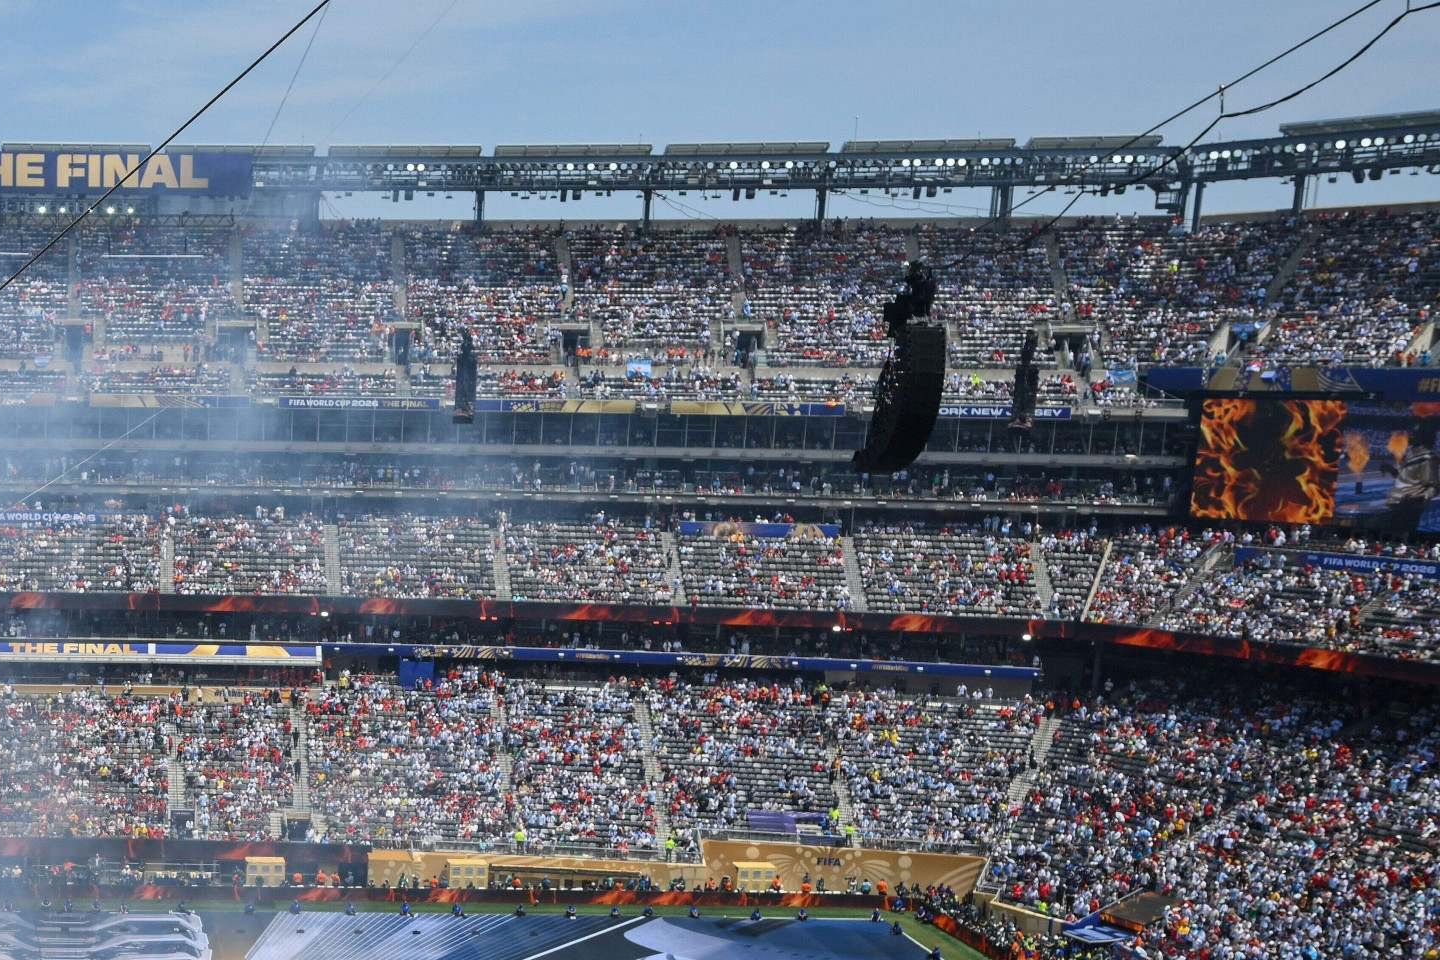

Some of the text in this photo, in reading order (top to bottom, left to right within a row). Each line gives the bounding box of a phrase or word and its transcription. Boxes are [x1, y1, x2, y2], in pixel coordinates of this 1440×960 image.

[56, 154, 209, 188] FINAL
[289, 399, 305, 407] FIFA
[305, 399, 334, 407] WORLD
[382, 400, 400, 408] THE
[401, 400, 429, 408] FINAL
[971, 408, 1003, 416] NEW
[6, 513, 41, 521] WORLD
[1323, 557, 1343, 566] FIFA
[1344, 559, 1379, 569] WORLD
[1401, 563, 1437, 574] 2026
[9, 642, 138, 655] THE FINAL
[816, 856, 841, 867] FIFA
